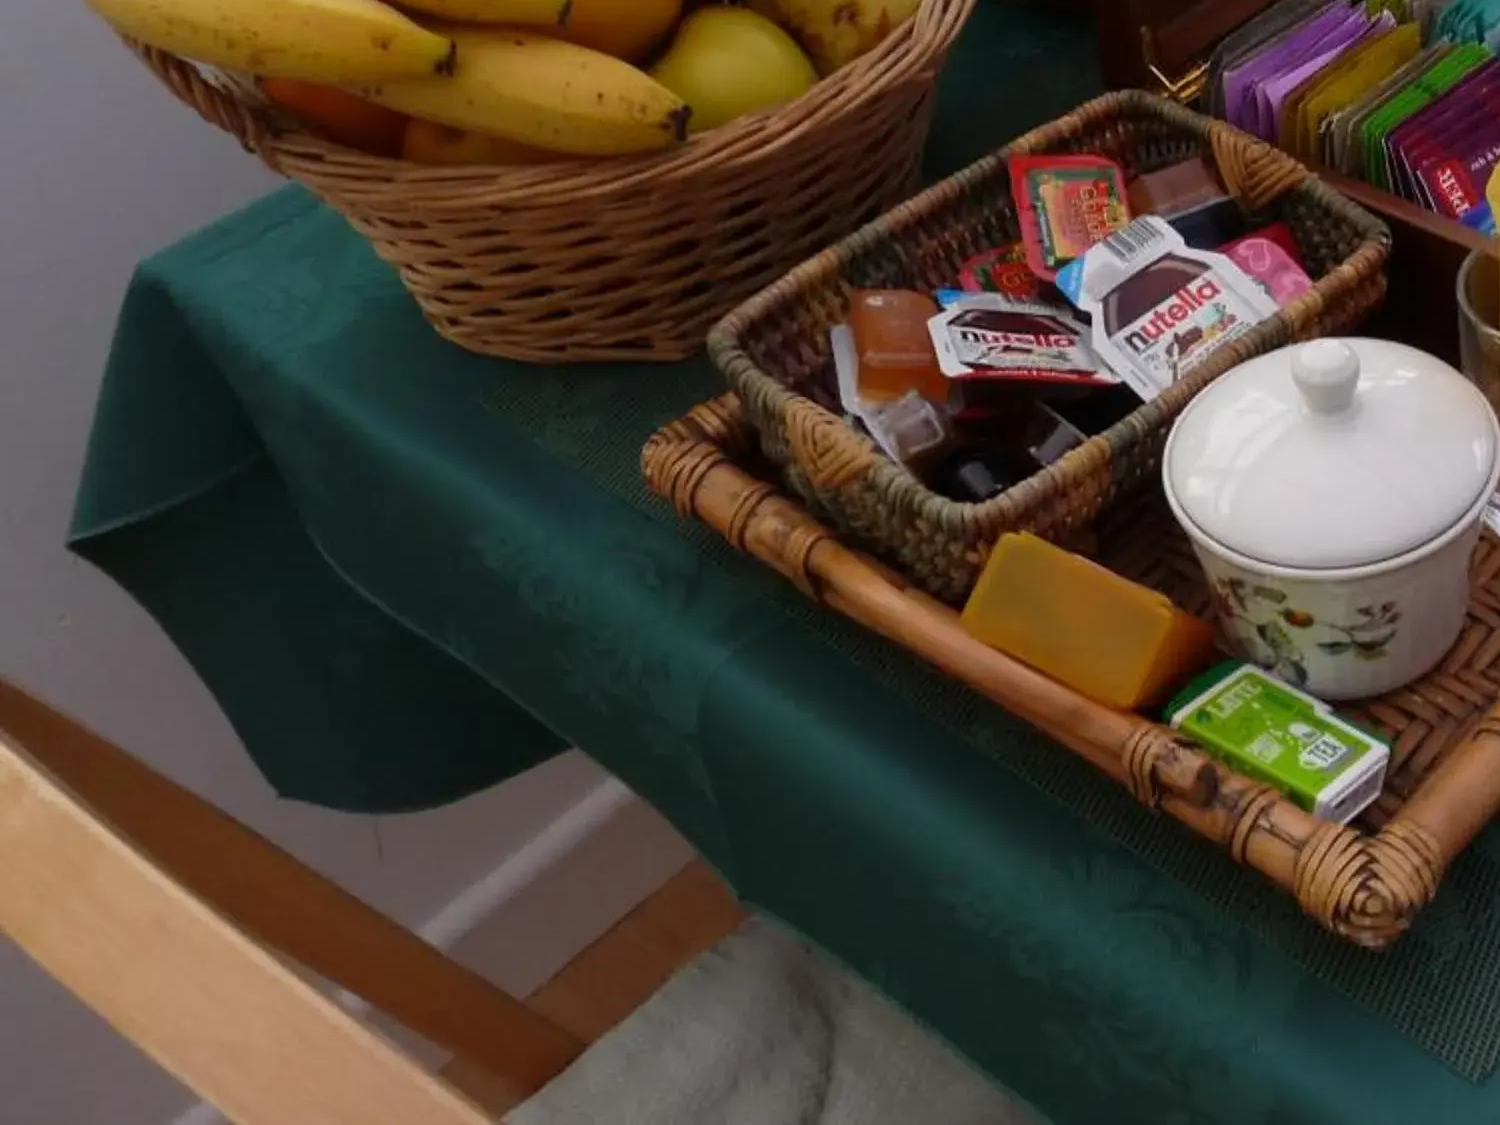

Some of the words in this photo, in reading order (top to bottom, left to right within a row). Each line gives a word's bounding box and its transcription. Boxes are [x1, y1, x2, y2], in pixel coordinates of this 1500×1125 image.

[1123, 278, 1222, 354] nutella
[959, 329, 1077, 349] nutella
[1306, 739, 1344, 764] TEA
